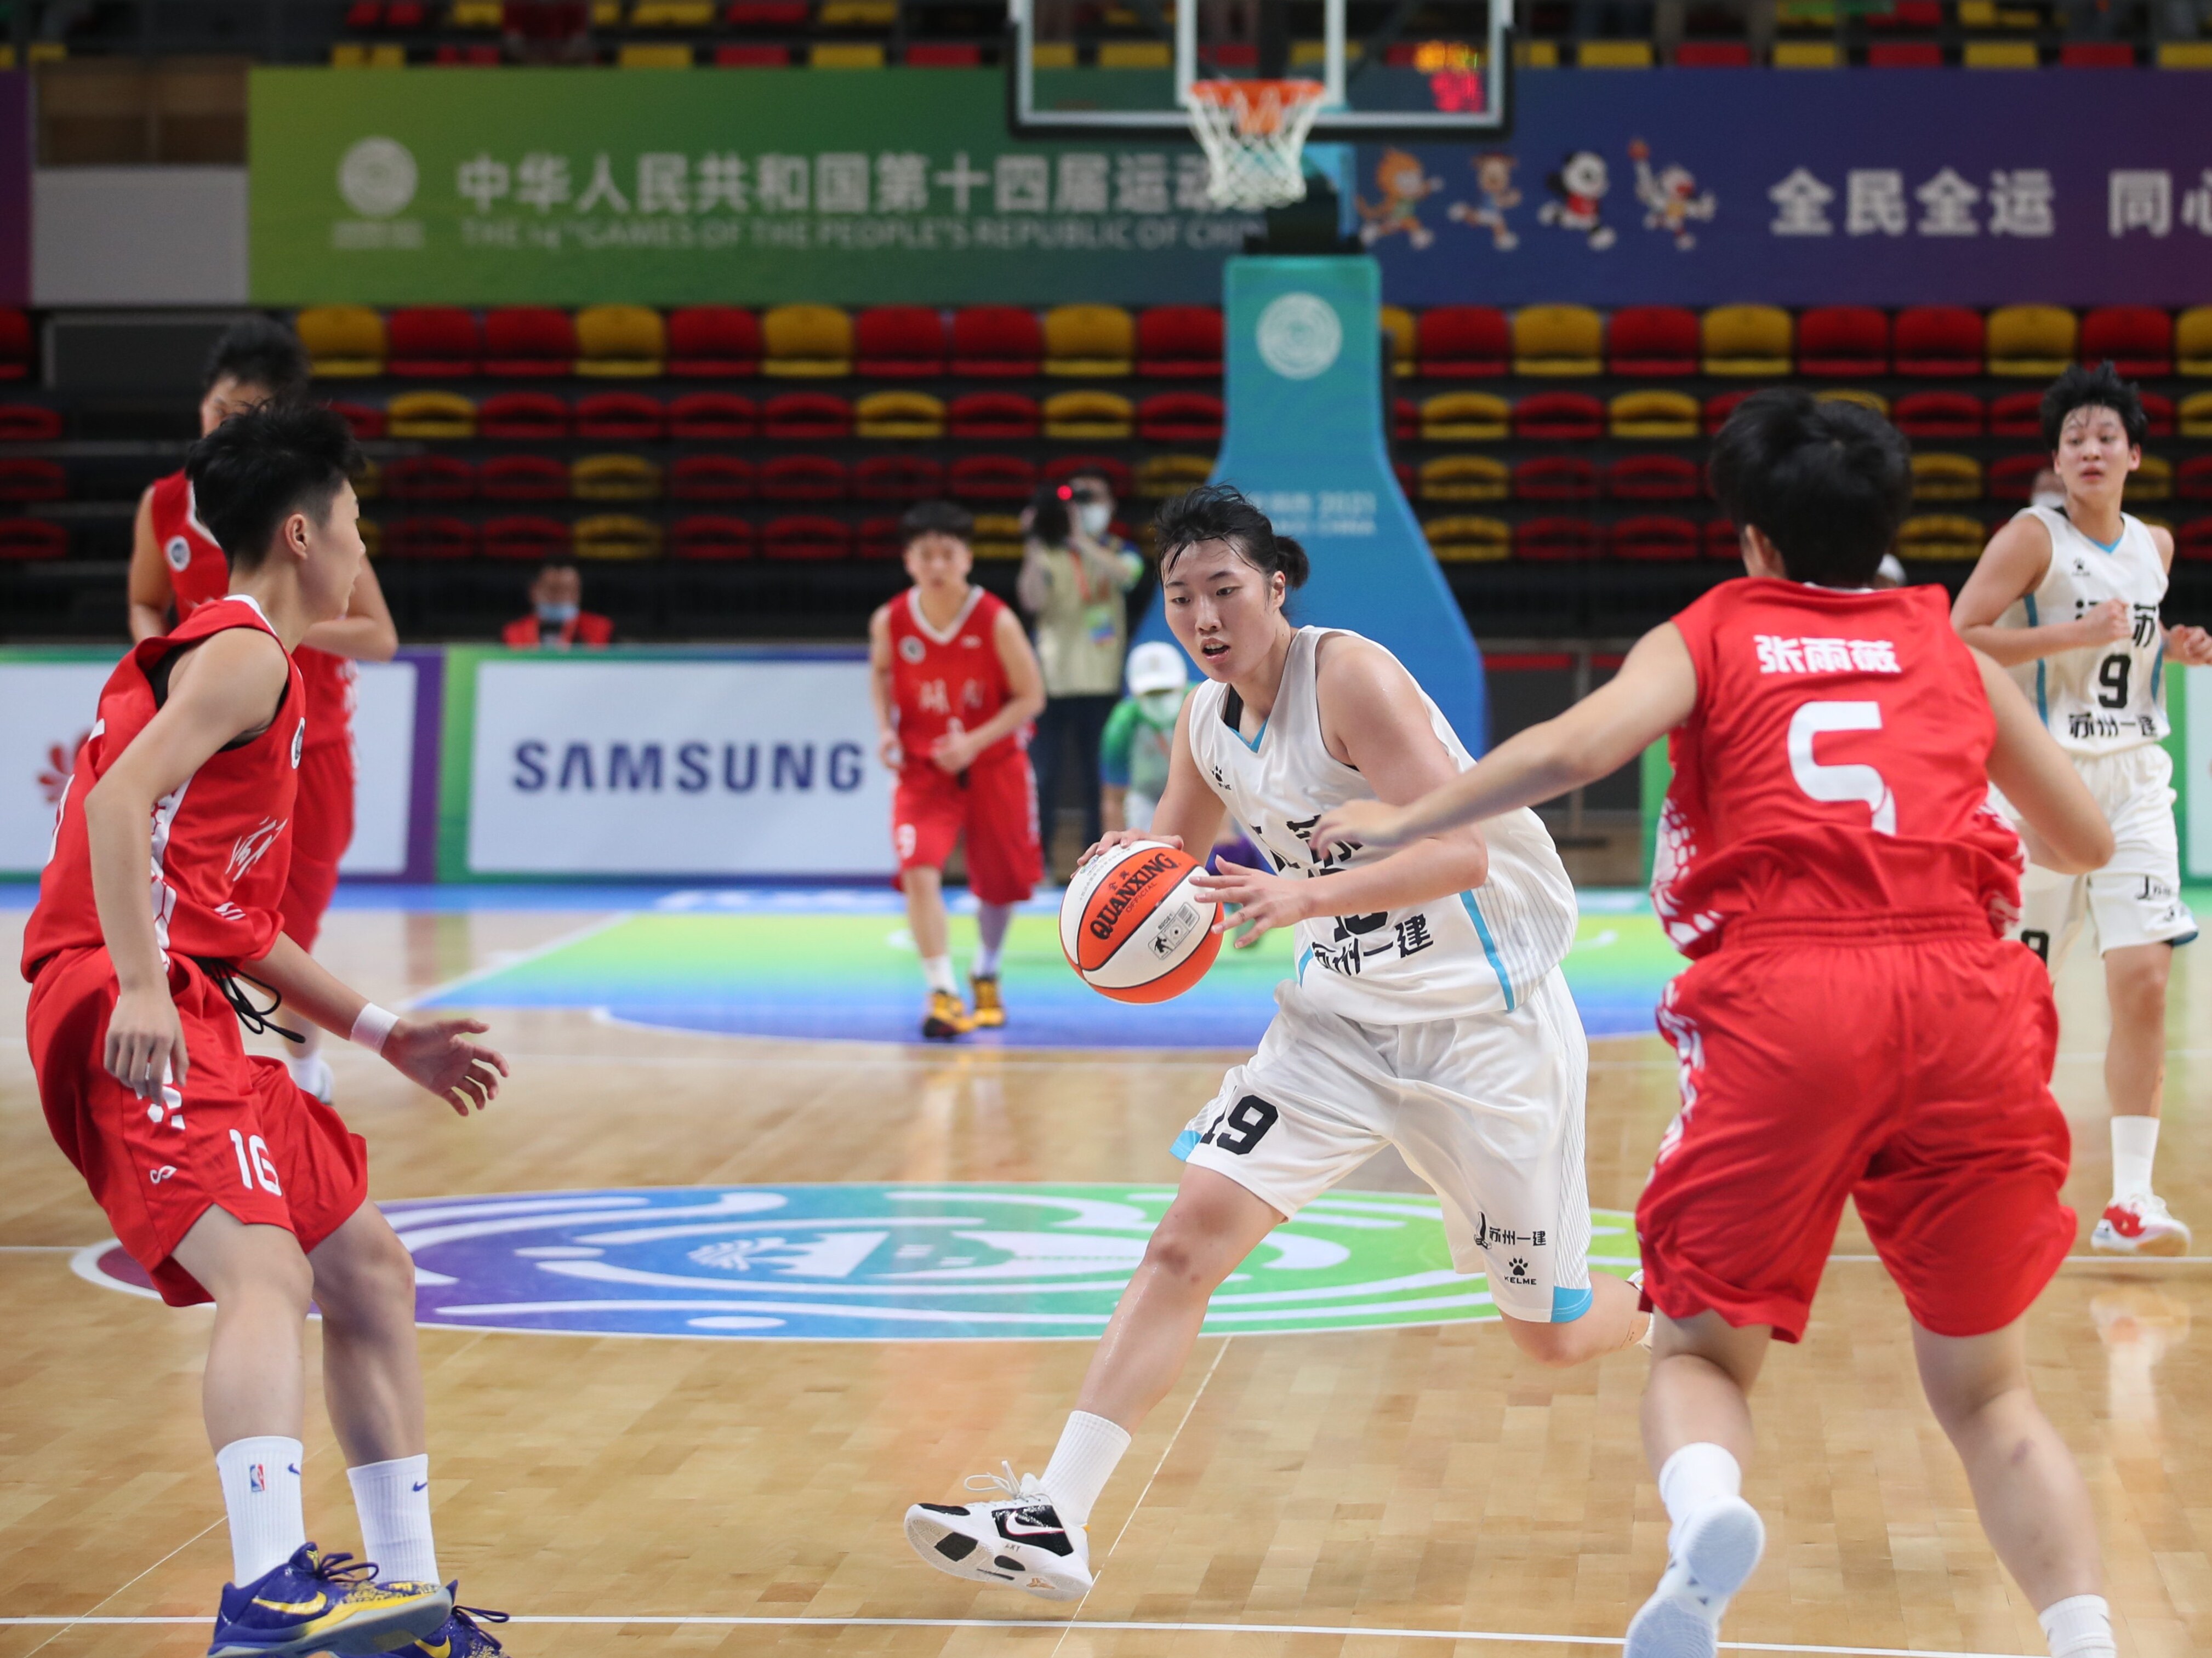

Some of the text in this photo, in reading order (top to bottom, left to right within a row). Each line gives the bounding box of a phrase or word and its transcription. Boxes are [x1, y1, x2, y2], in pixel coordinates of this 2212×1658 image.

[1767, 168, 2055, 237] 全民全运
[1754, 634, 1902, 673] 张雨薇
[2099, 653, 2131, 709] 9
[513, 742, 864, 793] SAMSUNG
[1787, 701, 1896, 837] 5
[1090, 853, 1179, 940] QUANXING
[1126, 882, 1158, 913] OFFICIAL
[1200, 1087, 1279, 1155] 19
[229, 1129, 282, 1196] 16
[1489, 1226, 1547, 1247] 苏州一建
[1504, 1276, 1537, 1285] KELME
